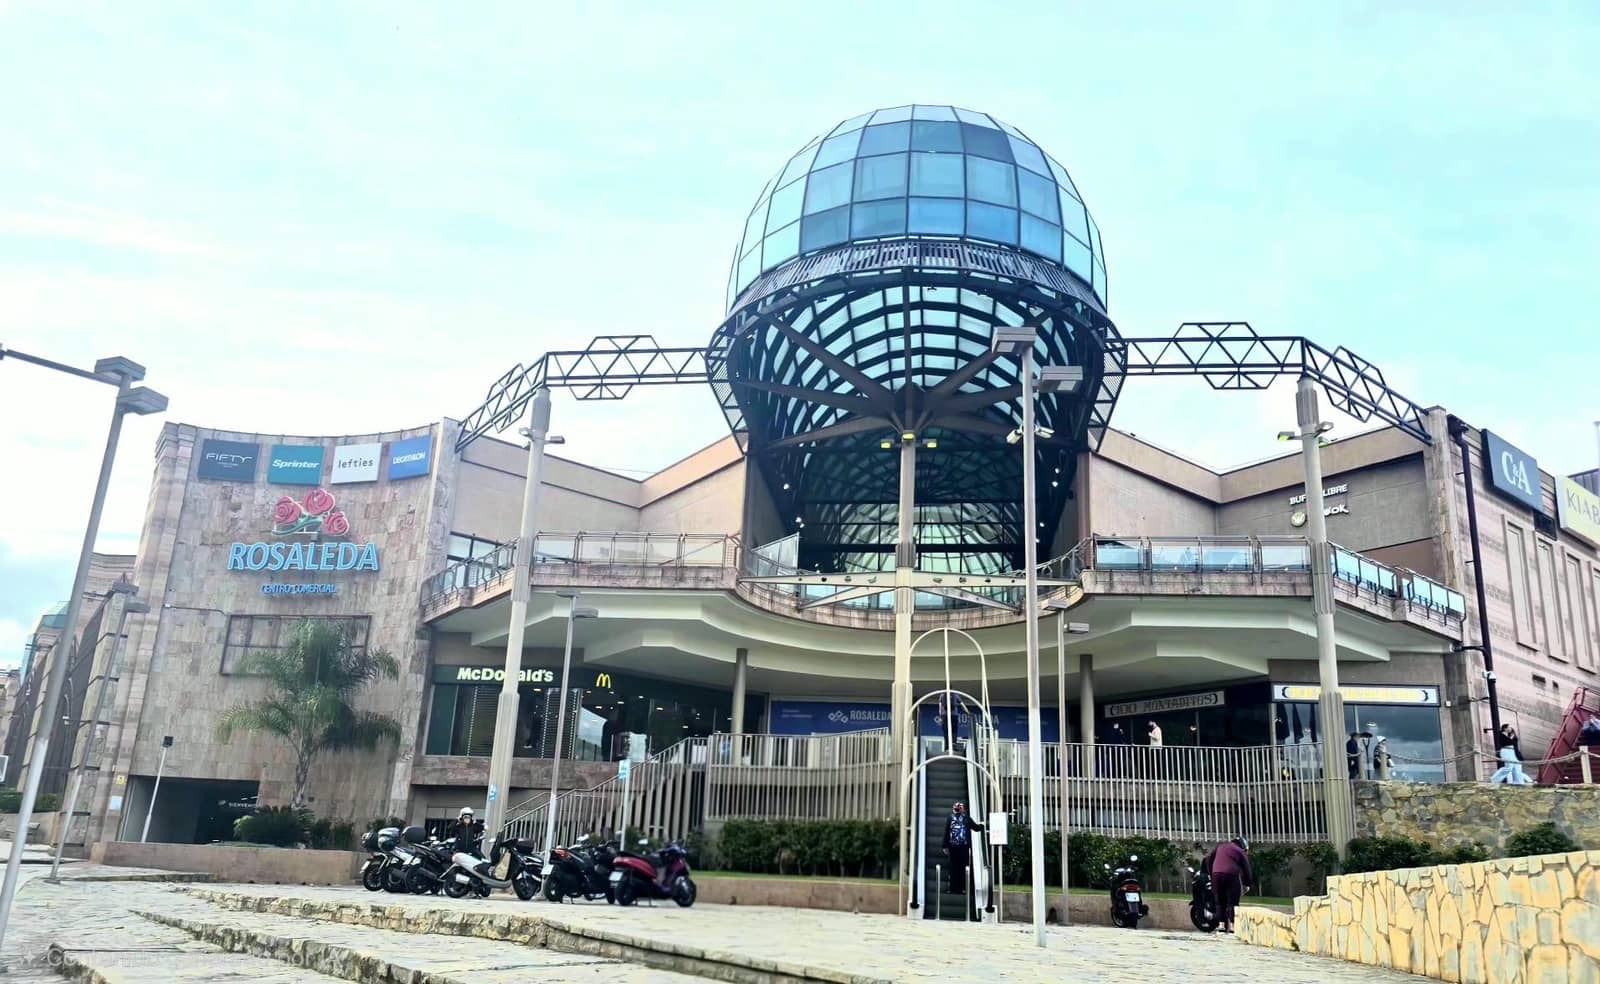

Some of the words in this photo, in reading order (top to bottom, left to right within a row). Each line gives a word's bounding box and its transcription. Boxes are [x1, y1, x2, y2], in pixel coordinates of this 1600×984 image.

[206, 452, 253, 463] FIFTY
[272, 459, 320, 469] Sprinter
[338, 457, 374, 469] lefties
[1501, 450, 1533, 496] C&A
[1322, 484, 1349, 497] LIBRE
[227, 541, 380, 572] ROSALEDA
[457, 667, 554, 683] McDoald's
